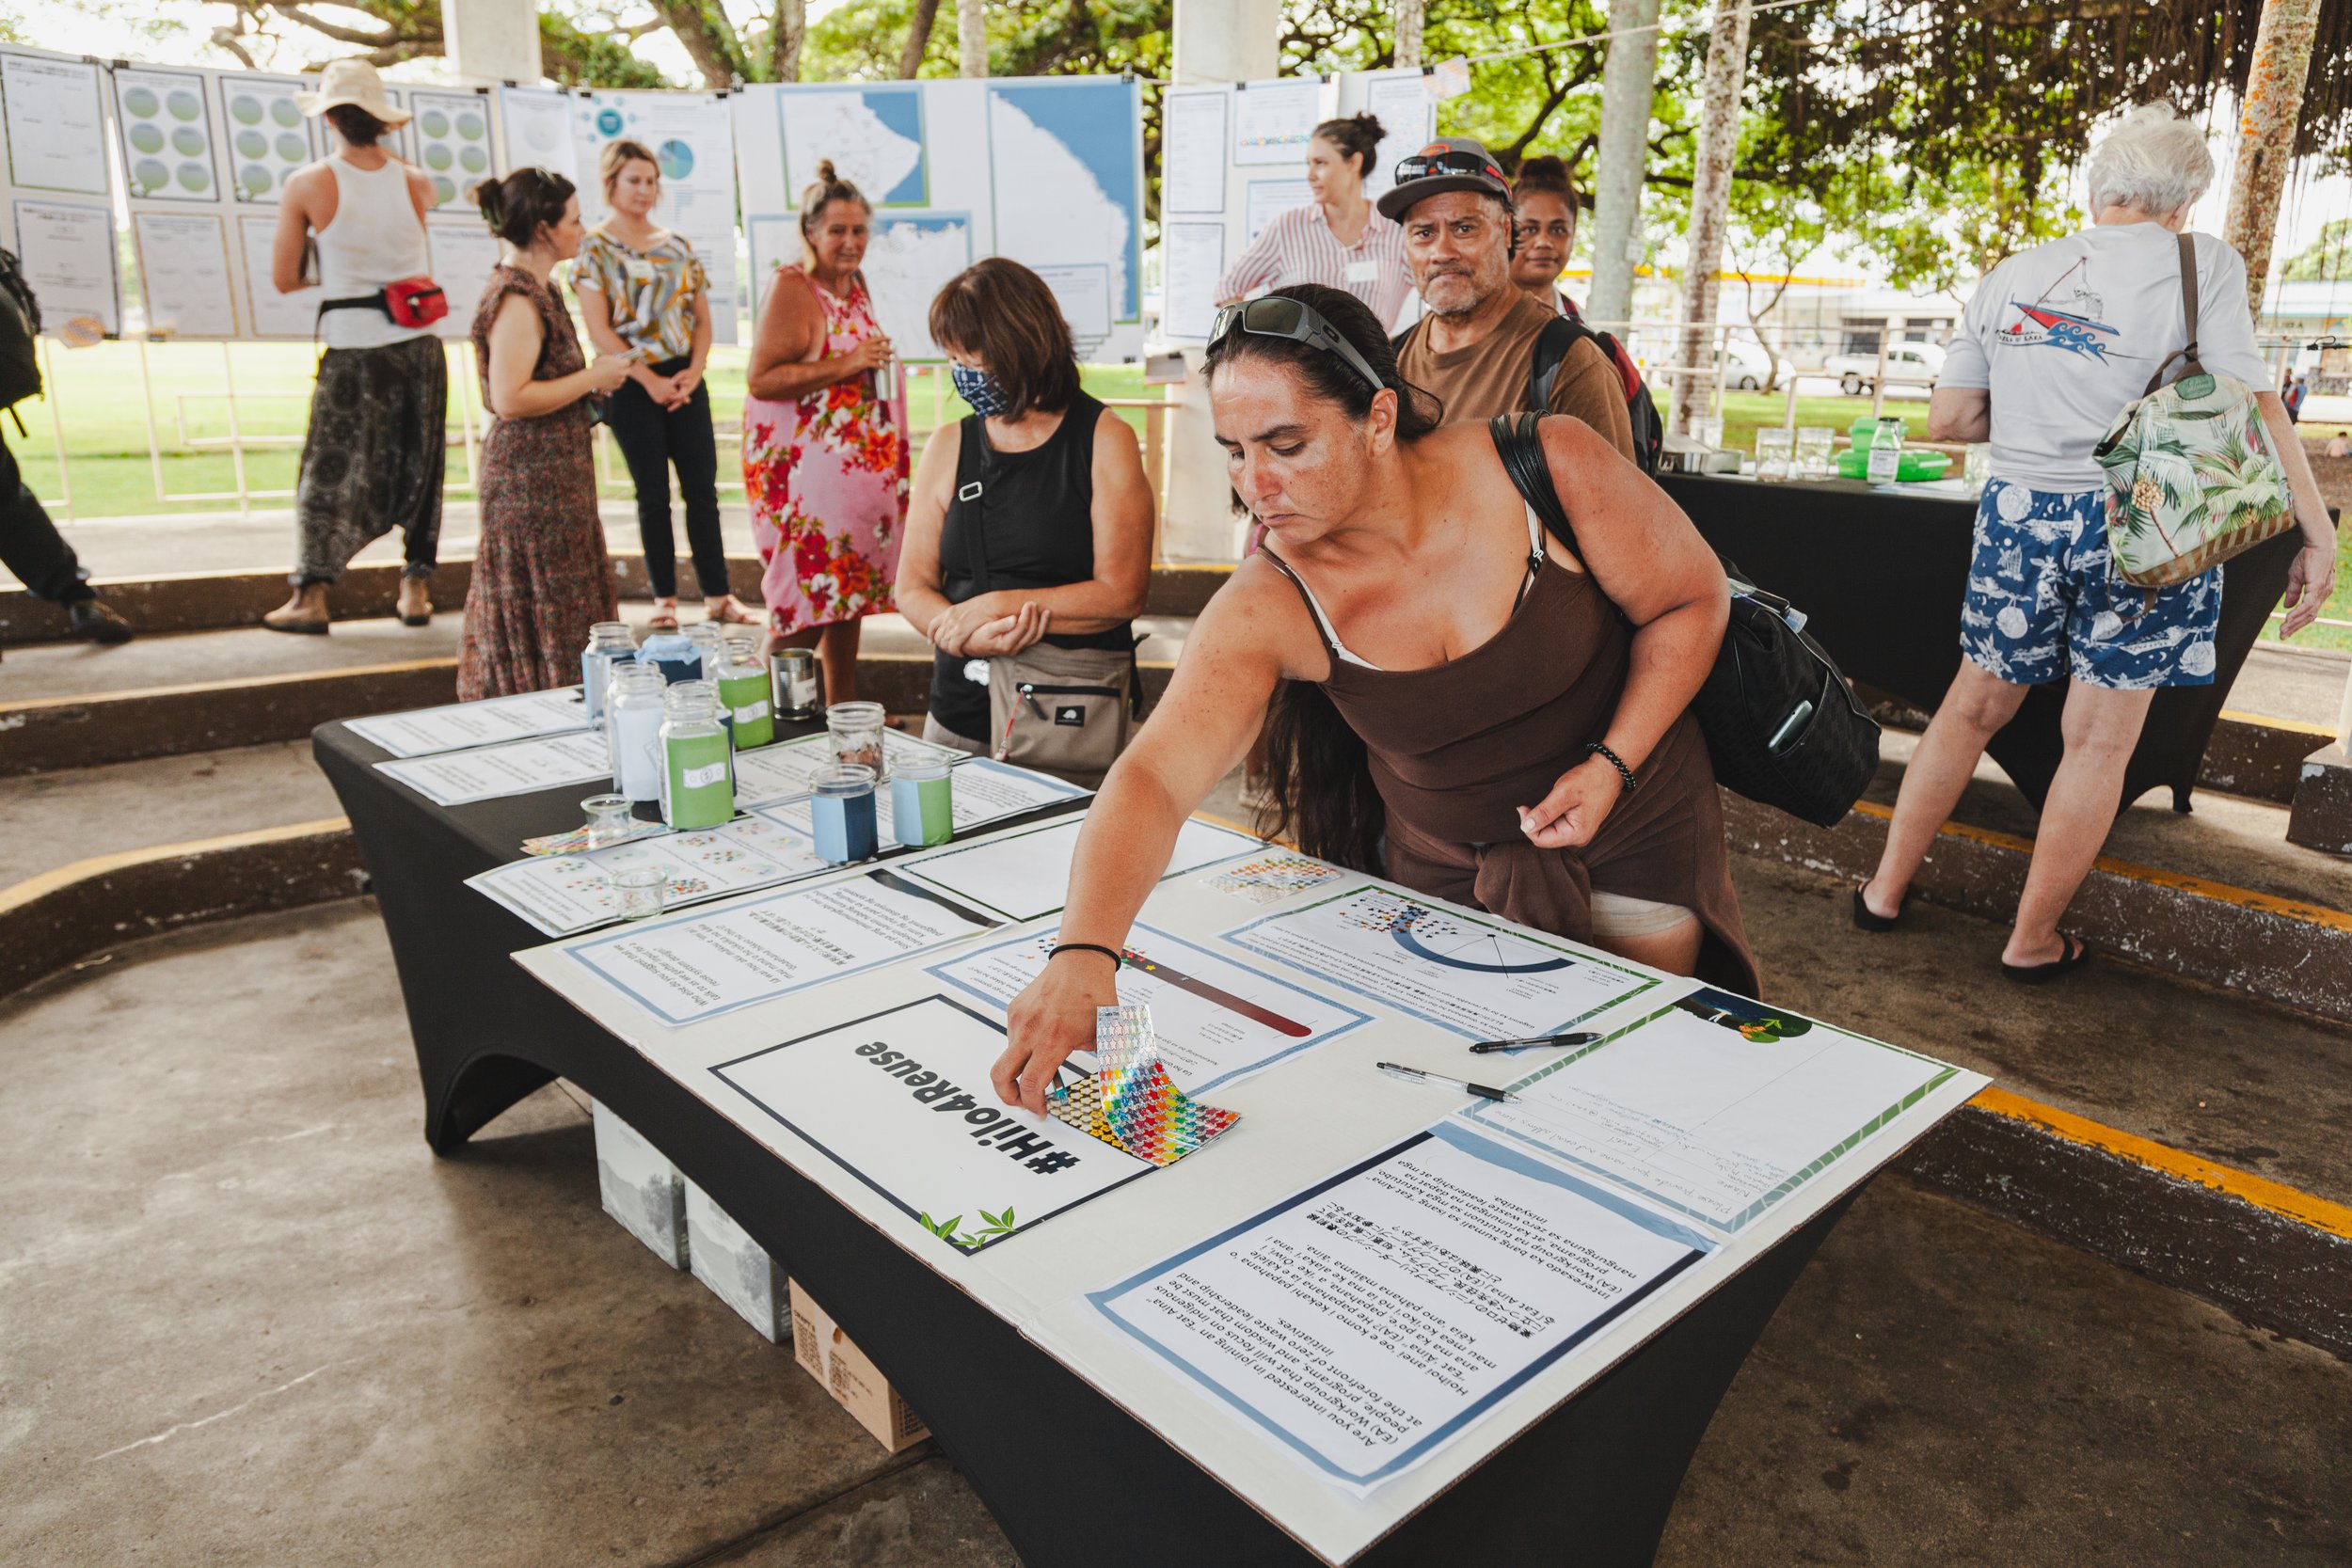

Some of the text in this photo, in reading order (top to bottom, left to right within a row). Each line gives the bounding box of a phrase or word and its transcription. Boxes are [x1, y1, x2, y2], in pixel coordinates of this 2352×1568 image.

[854, 1040, 1082, 1176] #Hilo4Reuse
[1397, 1160, 1420, 1172] mga
[1423, 1193, 1449, 1206] mga
[1432, 1177, 1487, 1206] leadership
[1417, 1198, 1447, 1216] isang
[1449, 1204, 1463, 1212] sa
[1487, 1203, 1520, 1222] waste
[1493, 1195, 1548, 1225] inisyatiba.
[1404, 1172, 1610, 1275] programa, at karunungan na dapat na
[1447, 1213, 1461, 1222] sa
[1463, 1211, 1513, 1241] tututuon
[1521, 1220, 1548, 1233] zero
[1459, 1220, 1499, 1242] sumali
[1548, 1231, 1563, 1240] sa
[1499, 1239, 1528, 1257] bang
[1514, 1236, 1530, 1246] na
[1529, 1254, 1545, 1265] ka
[1530, 1243, 1595, 1281] Workgroup
[1563, 1239, 1637, 1279] nangunguna
[1240, 1257, 1295, 1290] papahana
[1290, 1274, 1302, 1283] ia
[1331, 1272, 1347, 1283] ke
[1546, 1262, 1611, 1300] Interesado
[1346, 1280, 1366, 1293] ma
[1596, 1278, 1623, 1293] (EA)
[1289, 1288, 1330, 1313] kekahi
[1302, 1280, 1359, 1314] papahana
[1329, 1281, 1388, 1317] papahana,
[1366, 1291, 1378, 1301] ia
[1336, 1314, 1370, 1337] komo
[1357, 1312, 1374, 1325] He
[1199, 1328, 1216, 1339] an
[1277, 1317, 1334, 1357] initiatives.
[1372, 1323, 1405, 1342] (EA)?
[1415, 1333, 1432, 1346] ka
[1176, 1272, 1422, 1427] at the forefront of zero waste leadership and
[1214, 1338, 1257, 1367] joining
[1432, 1343, 1454, 1357] ma
[1439, 1334, 1467, 1352] mea
[1153, 1285, 1399, 1445] (EA) Workgroup that will focus on indigenous
[1168, 1279, 1410, 1433] people, programs, and wisdom that must be
[1396, 1351, 1426, 1370] anei
[1454, 1355, 1479, 1372] ana
[1467, 1350, 1497, 1369] mau
[1252, 1364, 1266, 1375] in
[1424, 1368, 1469, 1396] Hoihoi
[1263, 1372, 1327, 1415] interested
[1327, 1412, 1355, 1431] you
[1352, 1429, 1376, 1447] Are
